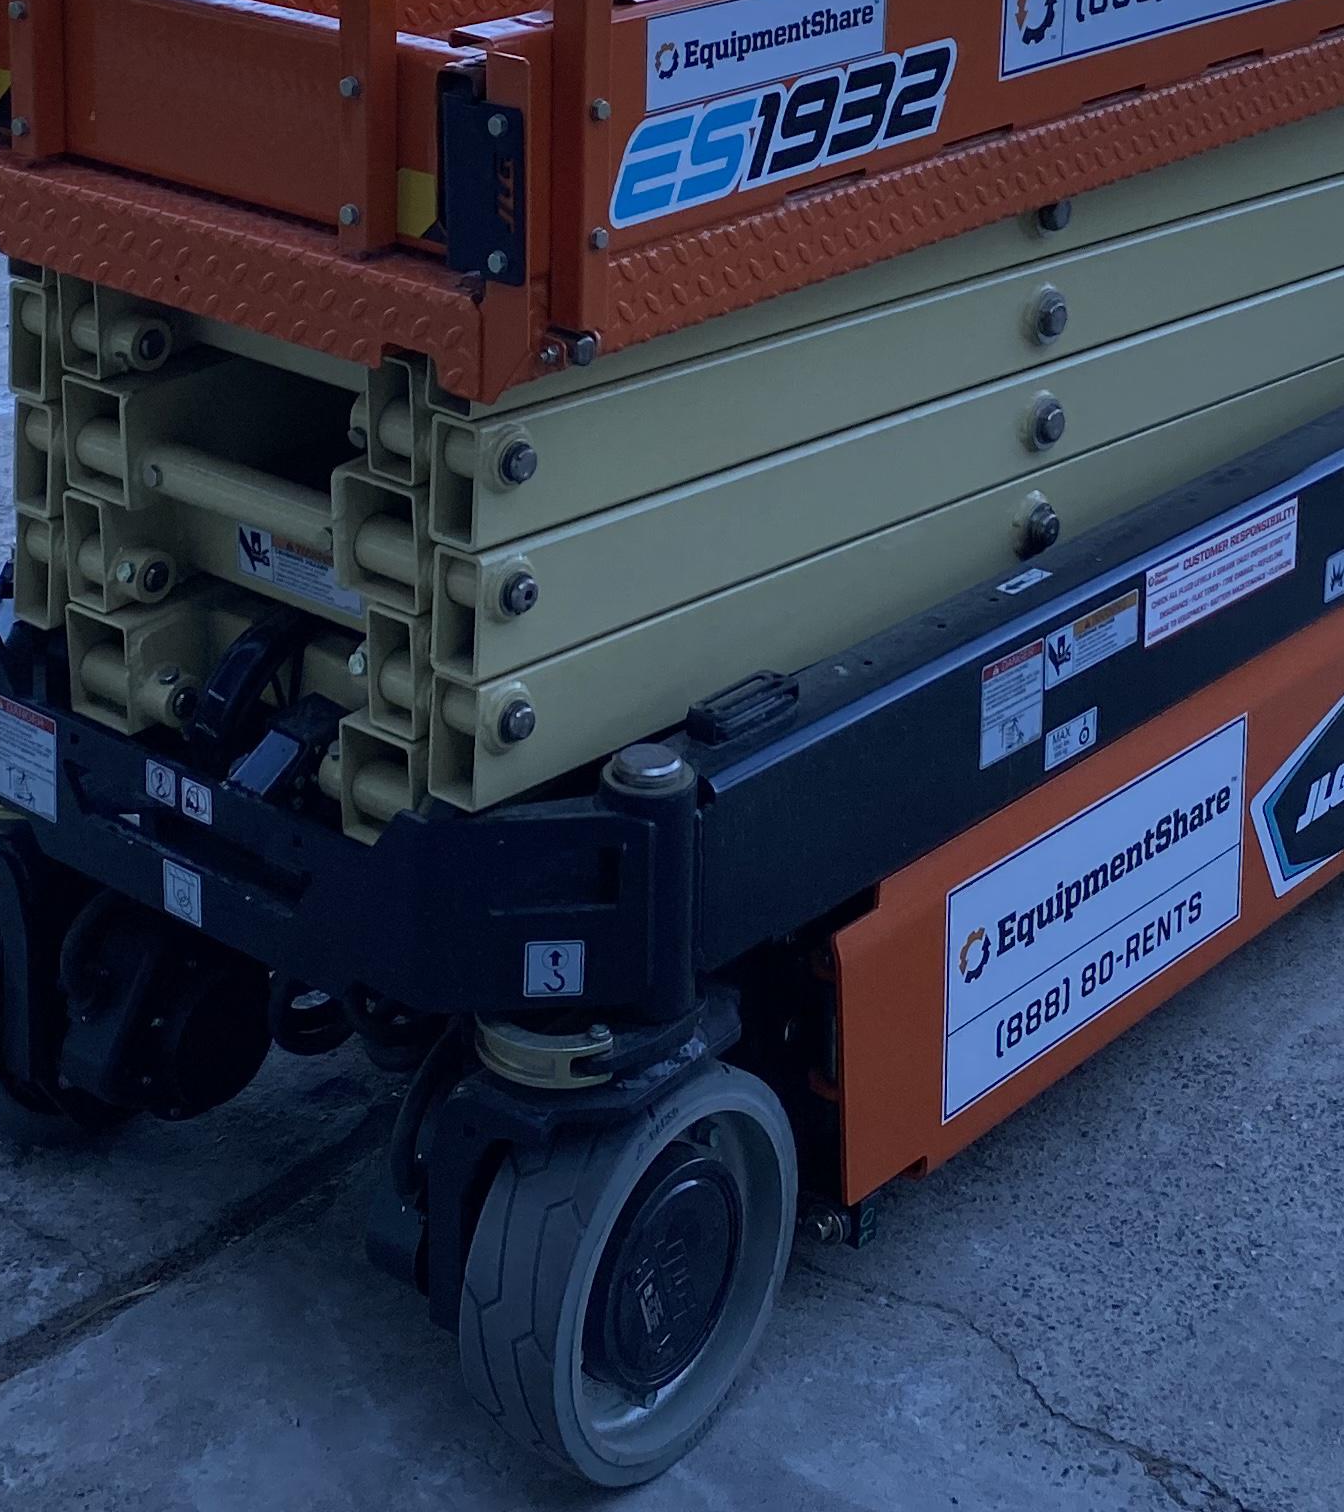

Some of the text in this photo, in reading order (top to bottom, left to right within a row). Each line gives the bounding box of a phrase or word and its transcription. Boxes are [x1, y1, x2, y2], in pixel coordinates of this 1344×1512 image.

[683, 4, 874, 69] EquipmentShare
[612, 44, 953, 223] ES1932
[1183, 539, 1229, 570] CUSTOMER
[1230, 506, 1296, 547] RESPONSIBILITY
[996, 786, 1231, 957] EquipmentShare
[996, 891, 1203, 1058] (888) 80-RENTS
